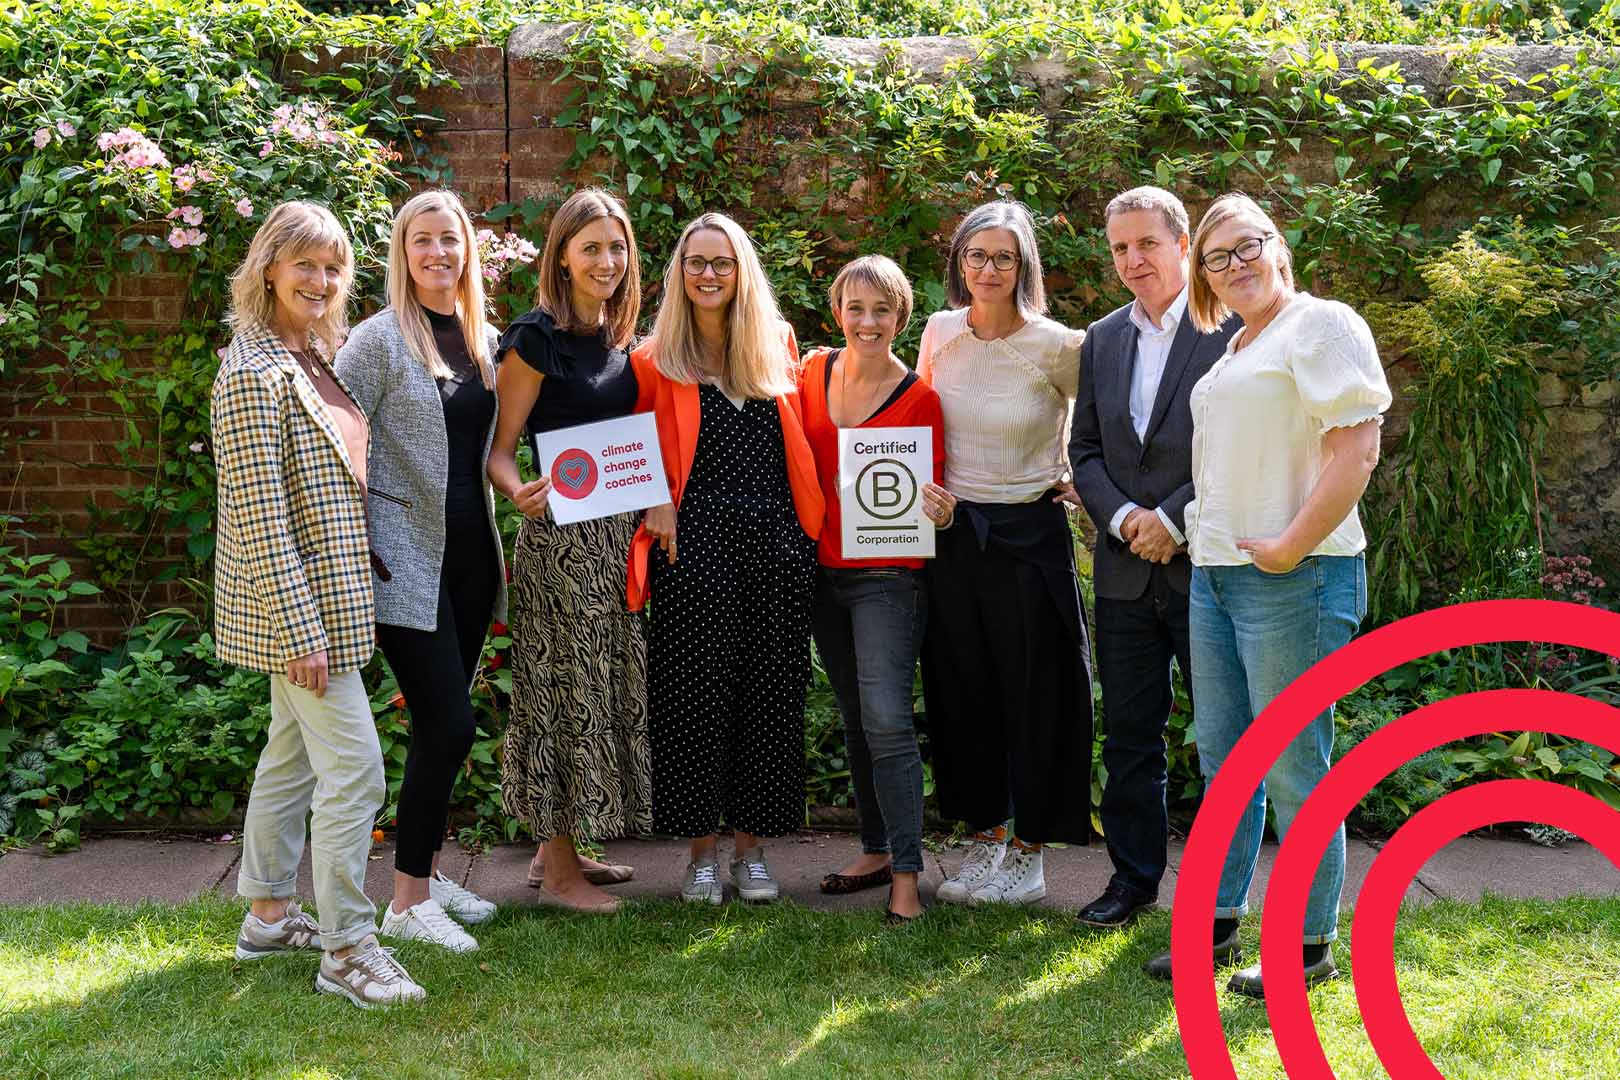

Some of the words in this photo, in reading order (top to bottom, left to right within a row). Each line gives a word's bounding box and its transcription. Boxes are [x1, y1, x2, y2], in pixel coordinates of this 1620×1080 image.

[601, 442, 644, 457] climate
[854, 441, 917, 454] Certified
[604, 458, 647, 473] change
[605, 473, 652, 489] coaches
[873, 472, 901, 507] B
[857, 534, 919, 545] Corporation
